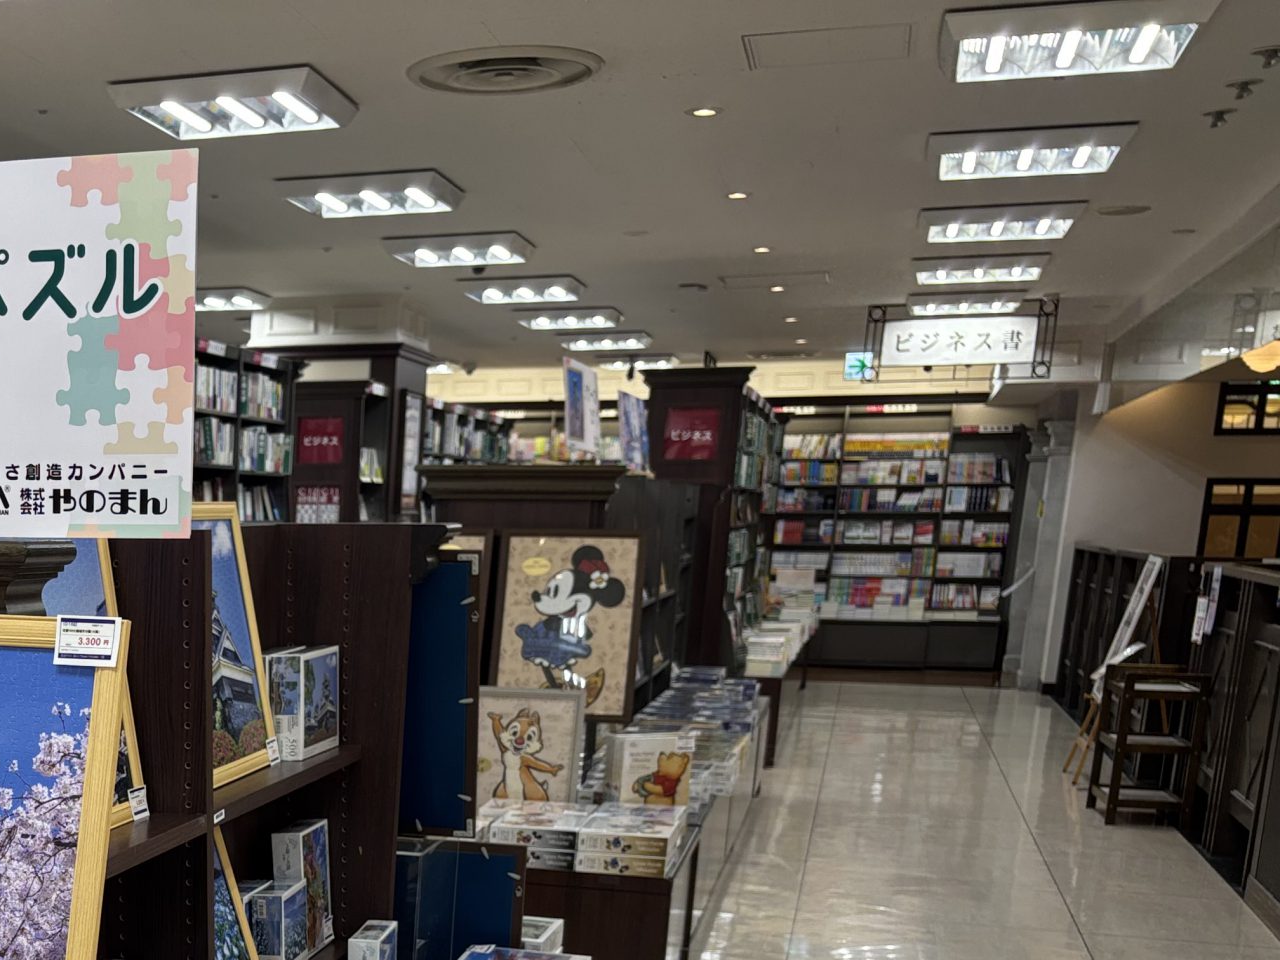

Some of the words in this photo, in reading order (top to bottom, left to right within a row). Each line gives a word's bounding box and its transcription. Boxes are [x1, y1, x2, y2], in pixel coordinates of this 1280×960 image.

[894, 330, 1025, 353] ビジネス書
[302, 435, 340, 447] ビジネス
[669, 429, 713, 442] ビジネス
[49, 488, 168, 515] やのまん
